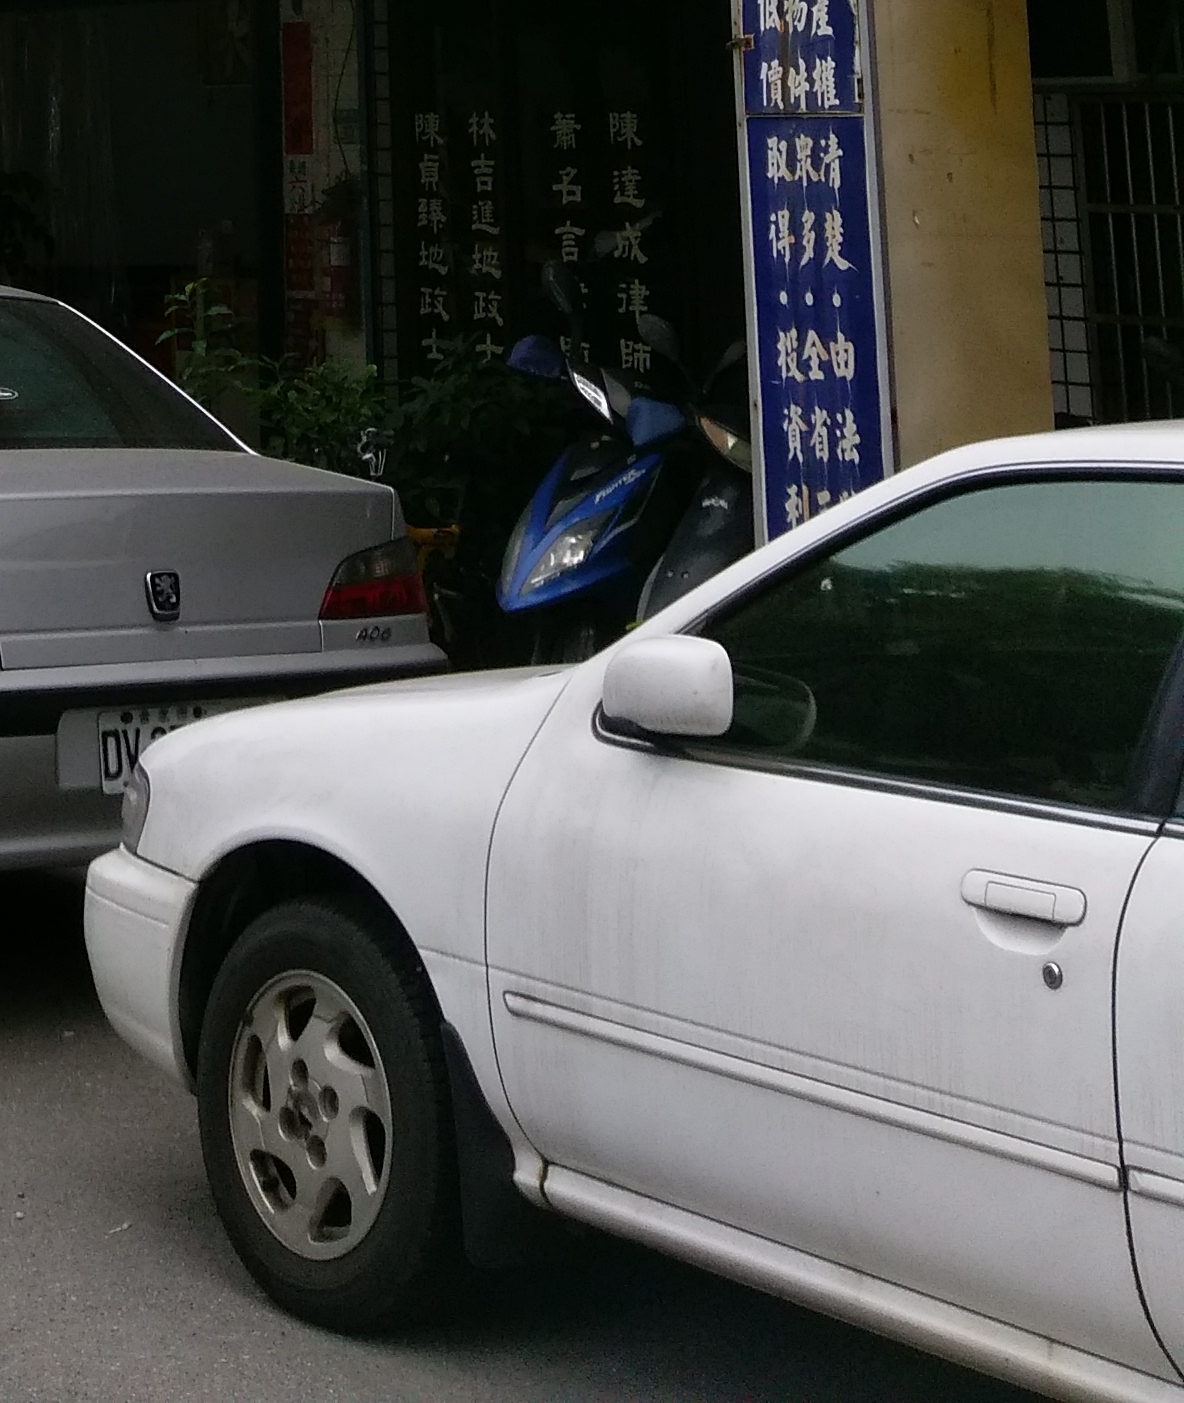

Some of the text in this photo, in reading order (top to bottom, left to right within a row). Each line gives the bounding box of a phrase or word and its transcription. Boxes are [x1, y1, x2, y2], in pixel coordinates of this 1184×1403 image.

[610, 111, 653, 374] 陳達成律師
[830, 330, 861, 505] 由法
